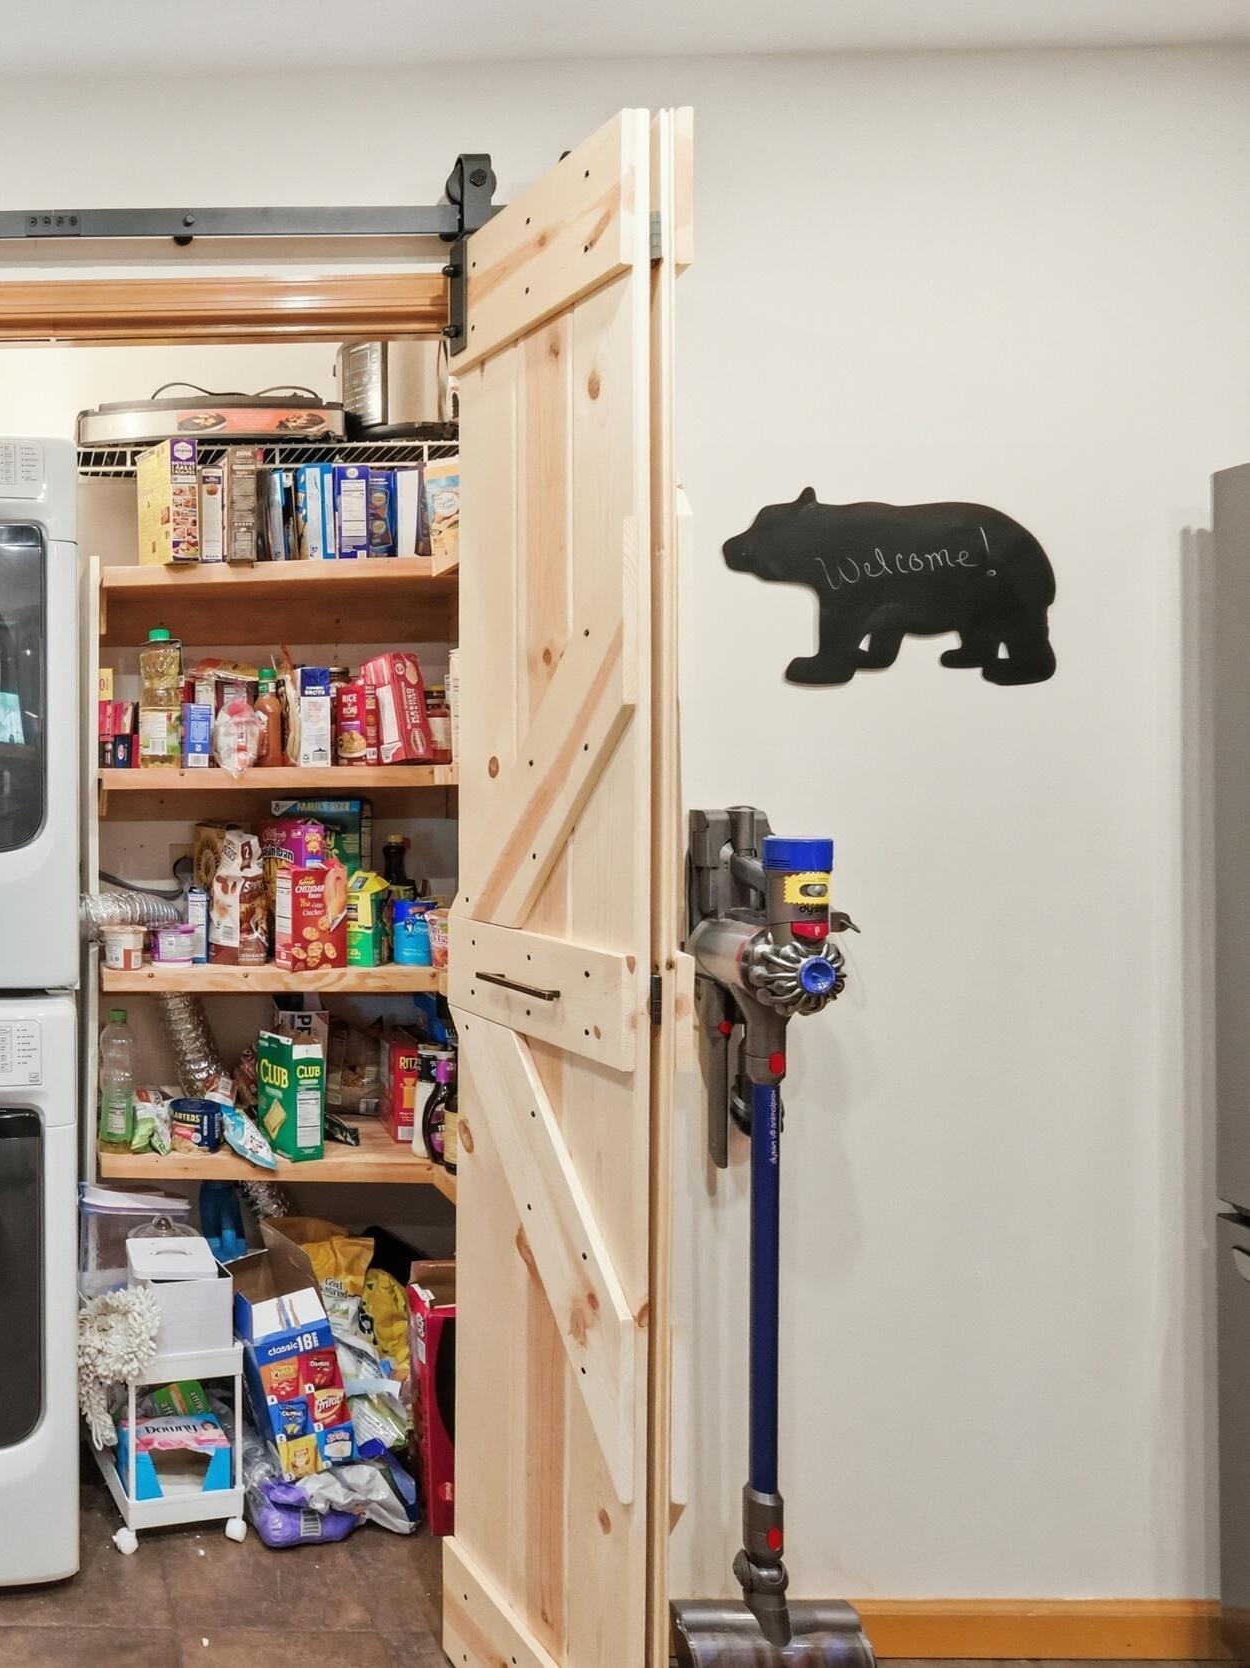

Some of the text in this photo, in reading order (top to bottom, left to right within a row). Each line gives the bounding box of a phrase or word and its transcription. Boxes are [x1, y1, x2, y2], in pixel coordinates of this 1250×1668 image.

[815, 526, 997, 590] Welcome!
[342, 694, 357, 703] RICE
[260, 1058, 289, 1089] CLUB
[296, 1065, 321, 1079] CLUB
[171, 1112, 200, 1124] LANTERS
[325, 1277, 343, 1290] Good
[268, 1342, 298, 1356] classic
[296, 1333, 312, 1352] 18
[144, 1424, 198, 1434] Downy
